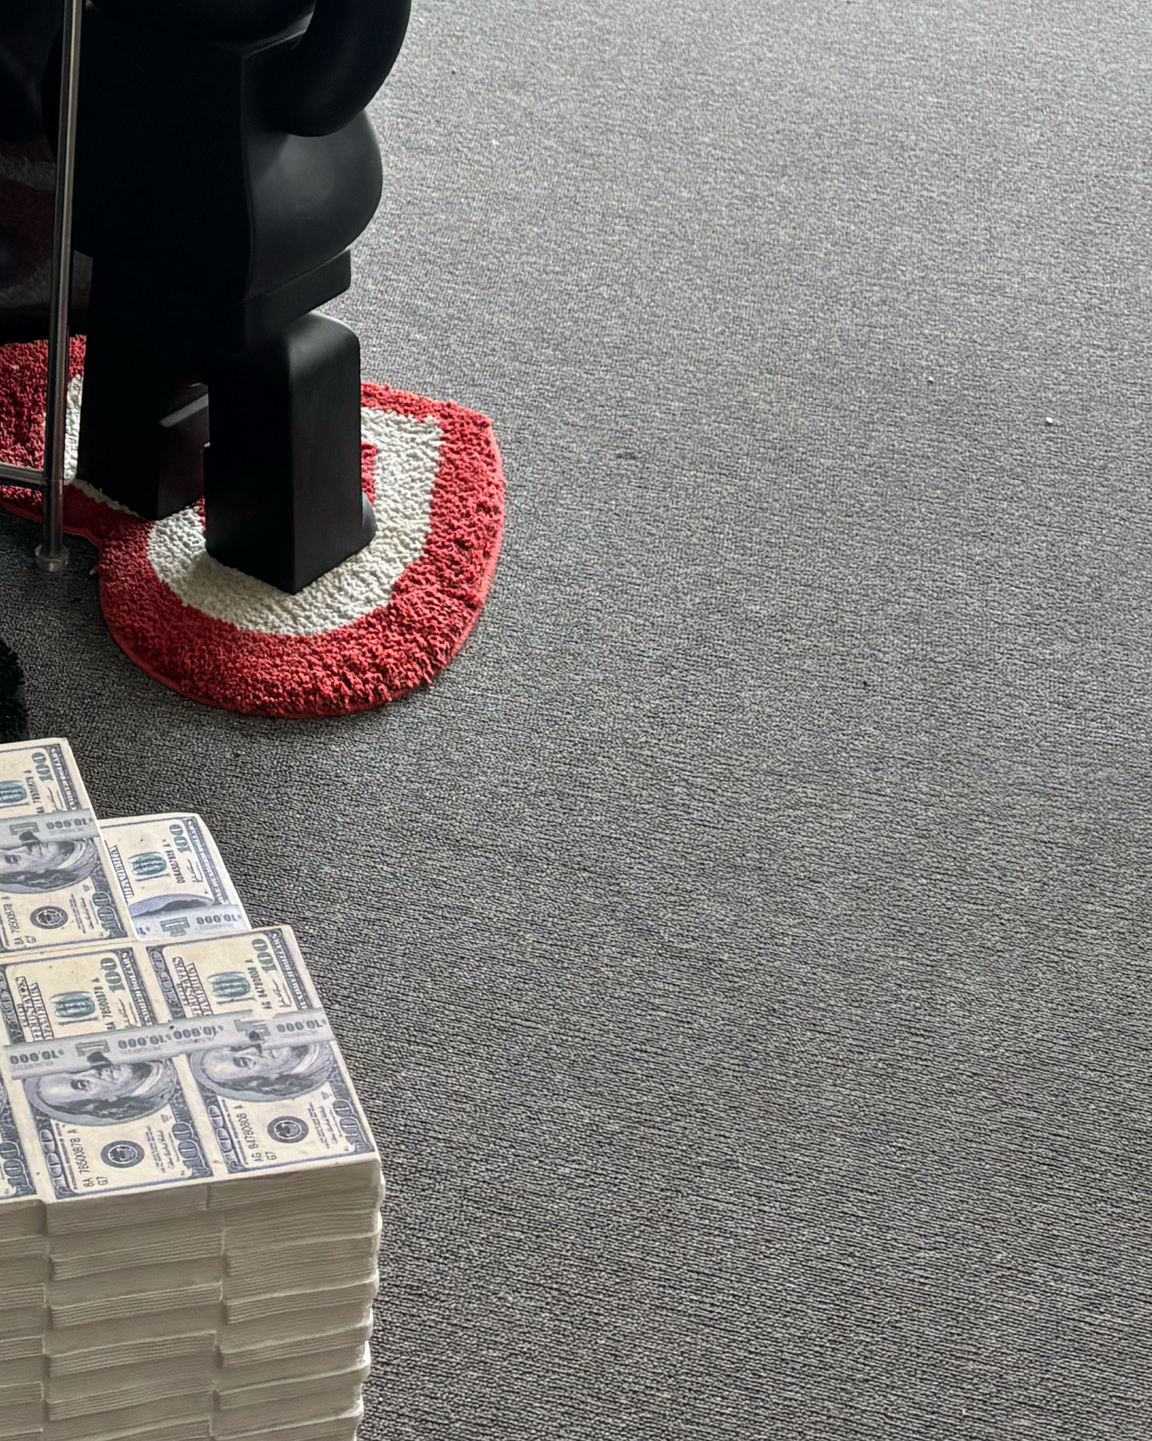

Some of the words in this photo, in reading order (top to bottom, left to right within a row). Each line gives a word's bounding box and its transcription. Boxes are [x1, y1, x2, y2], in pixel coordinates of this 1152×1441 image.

[30, 751, 54, 782] 100
[169, 824, 192, 853] 100
[89, 890, 120, 930] 100
[250, 937, 278, 973] 100
[99, 956, 126, 992] 100
[329, 1097, 366, 1144] 100
[169, 1120, 205, 1168] 100
